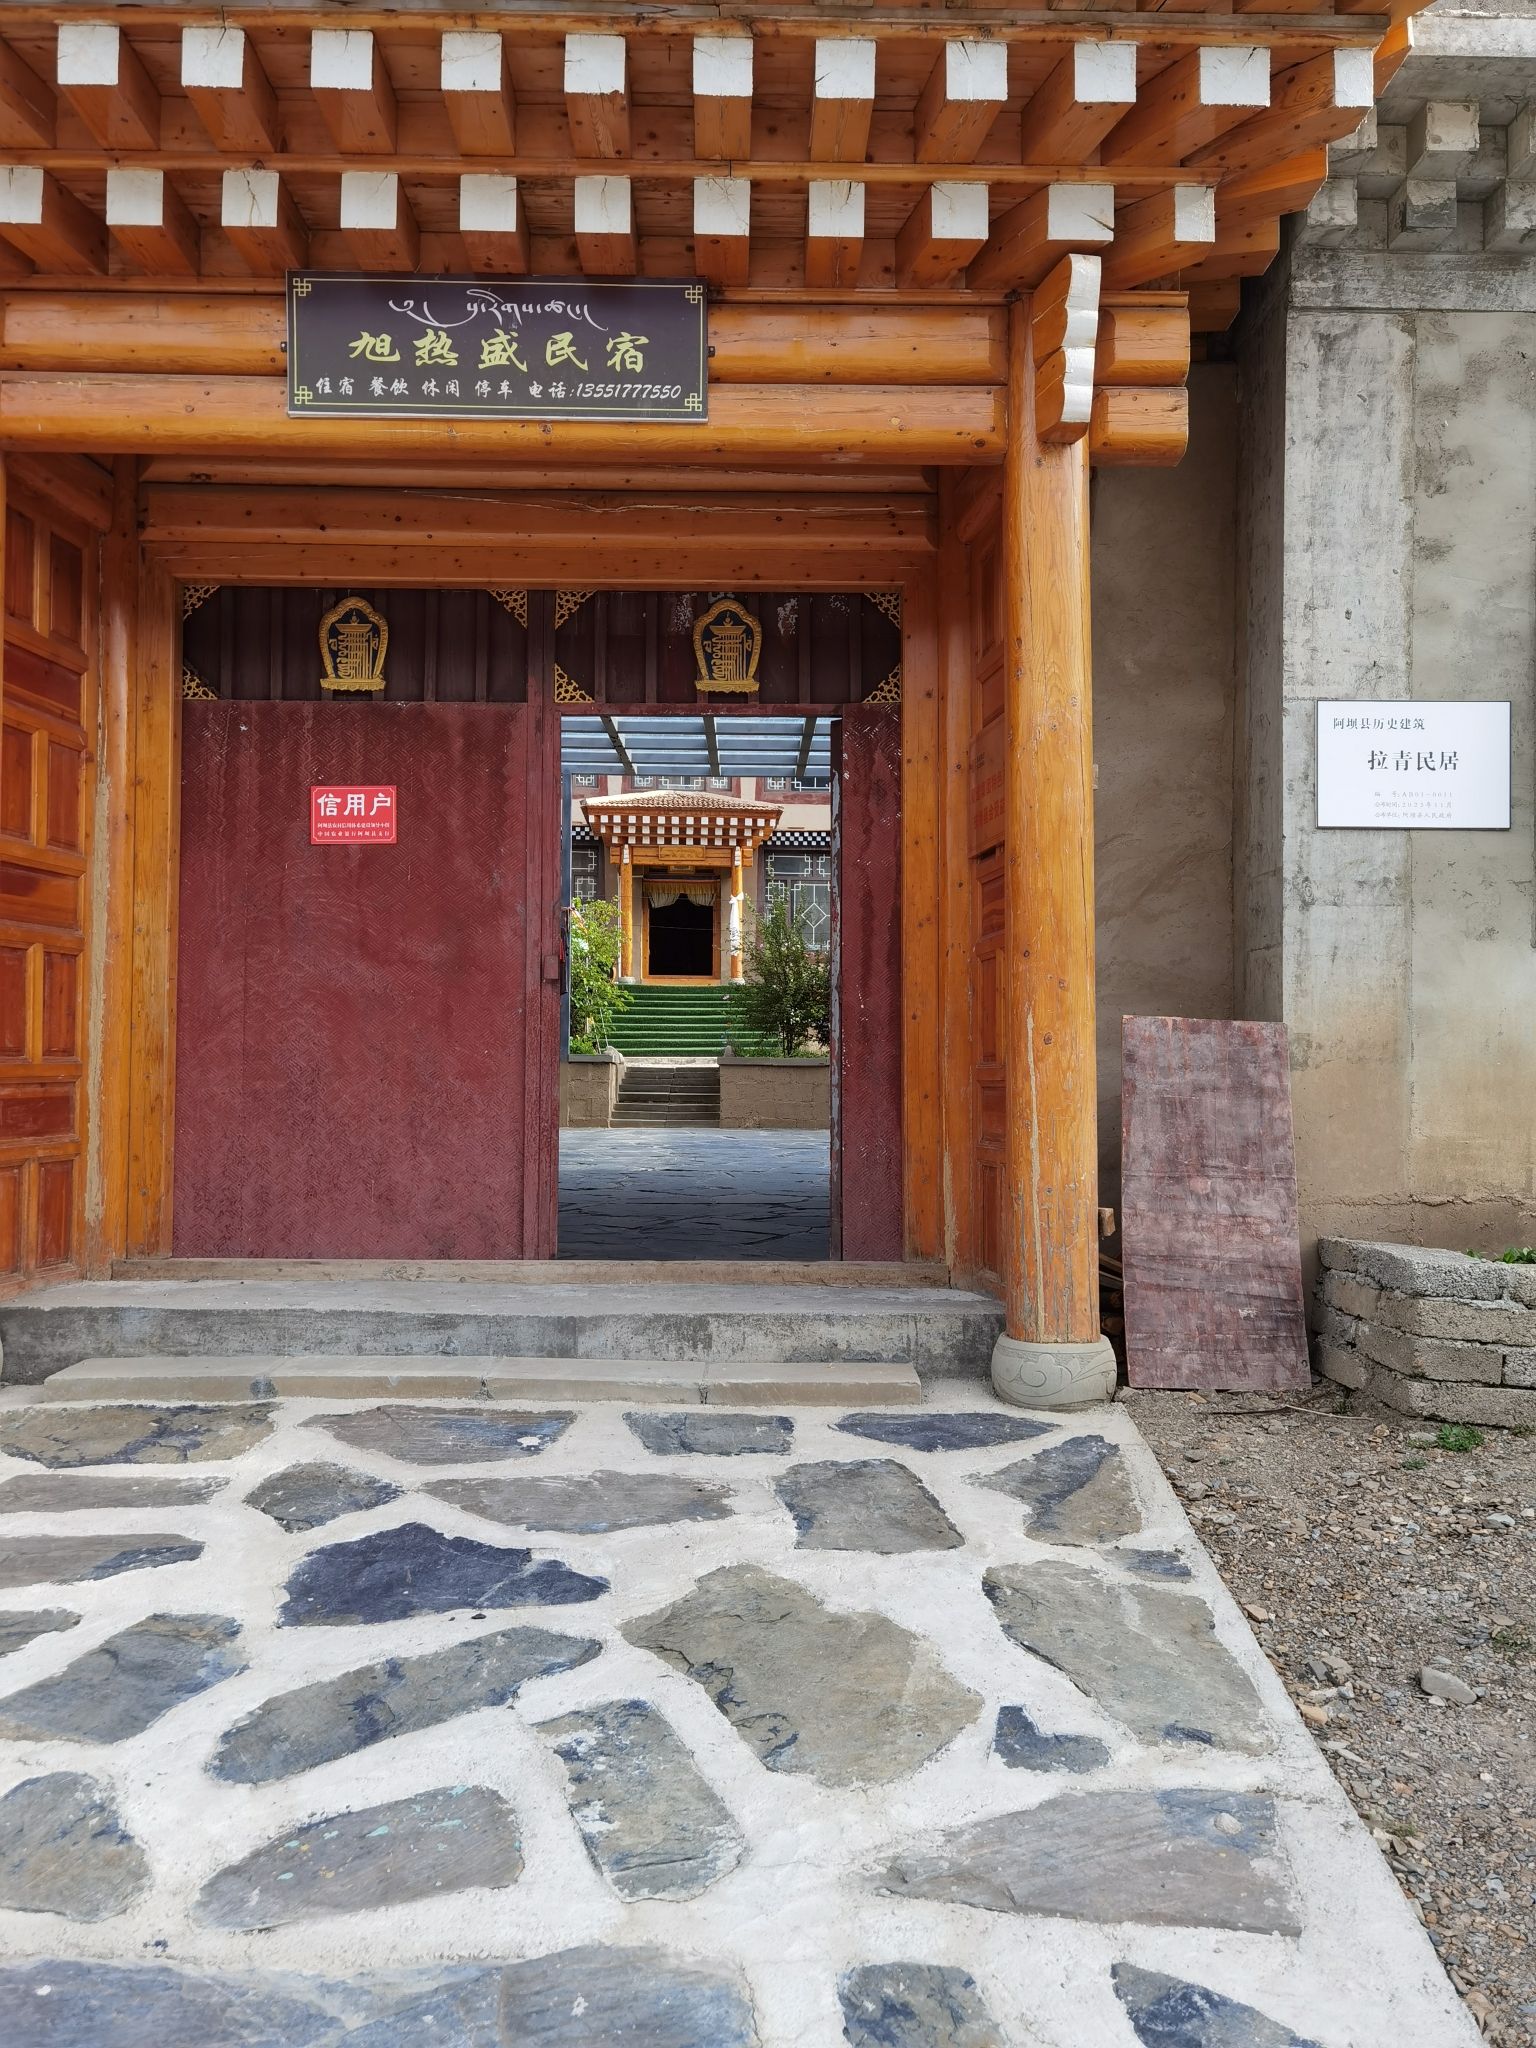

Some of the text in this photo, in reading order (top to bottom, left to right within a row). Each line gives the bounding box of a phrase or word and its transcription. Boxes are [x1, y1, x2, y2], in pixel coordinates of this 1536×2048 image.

[348, 328, 650, 374] 旭热盛民宿
[316, 377, 355, 395] 住宿
[369, 376, 409, 397] 餐饮
[422, 378, 460, 397] 休闲
[475, 379, 513, 399] 停车
[1333, 717, 1425, 731] 阿坝县历史建筑
[1368, 750, 1459, 771] 拉青民居
[317, 792, 391, 817] 信用户
